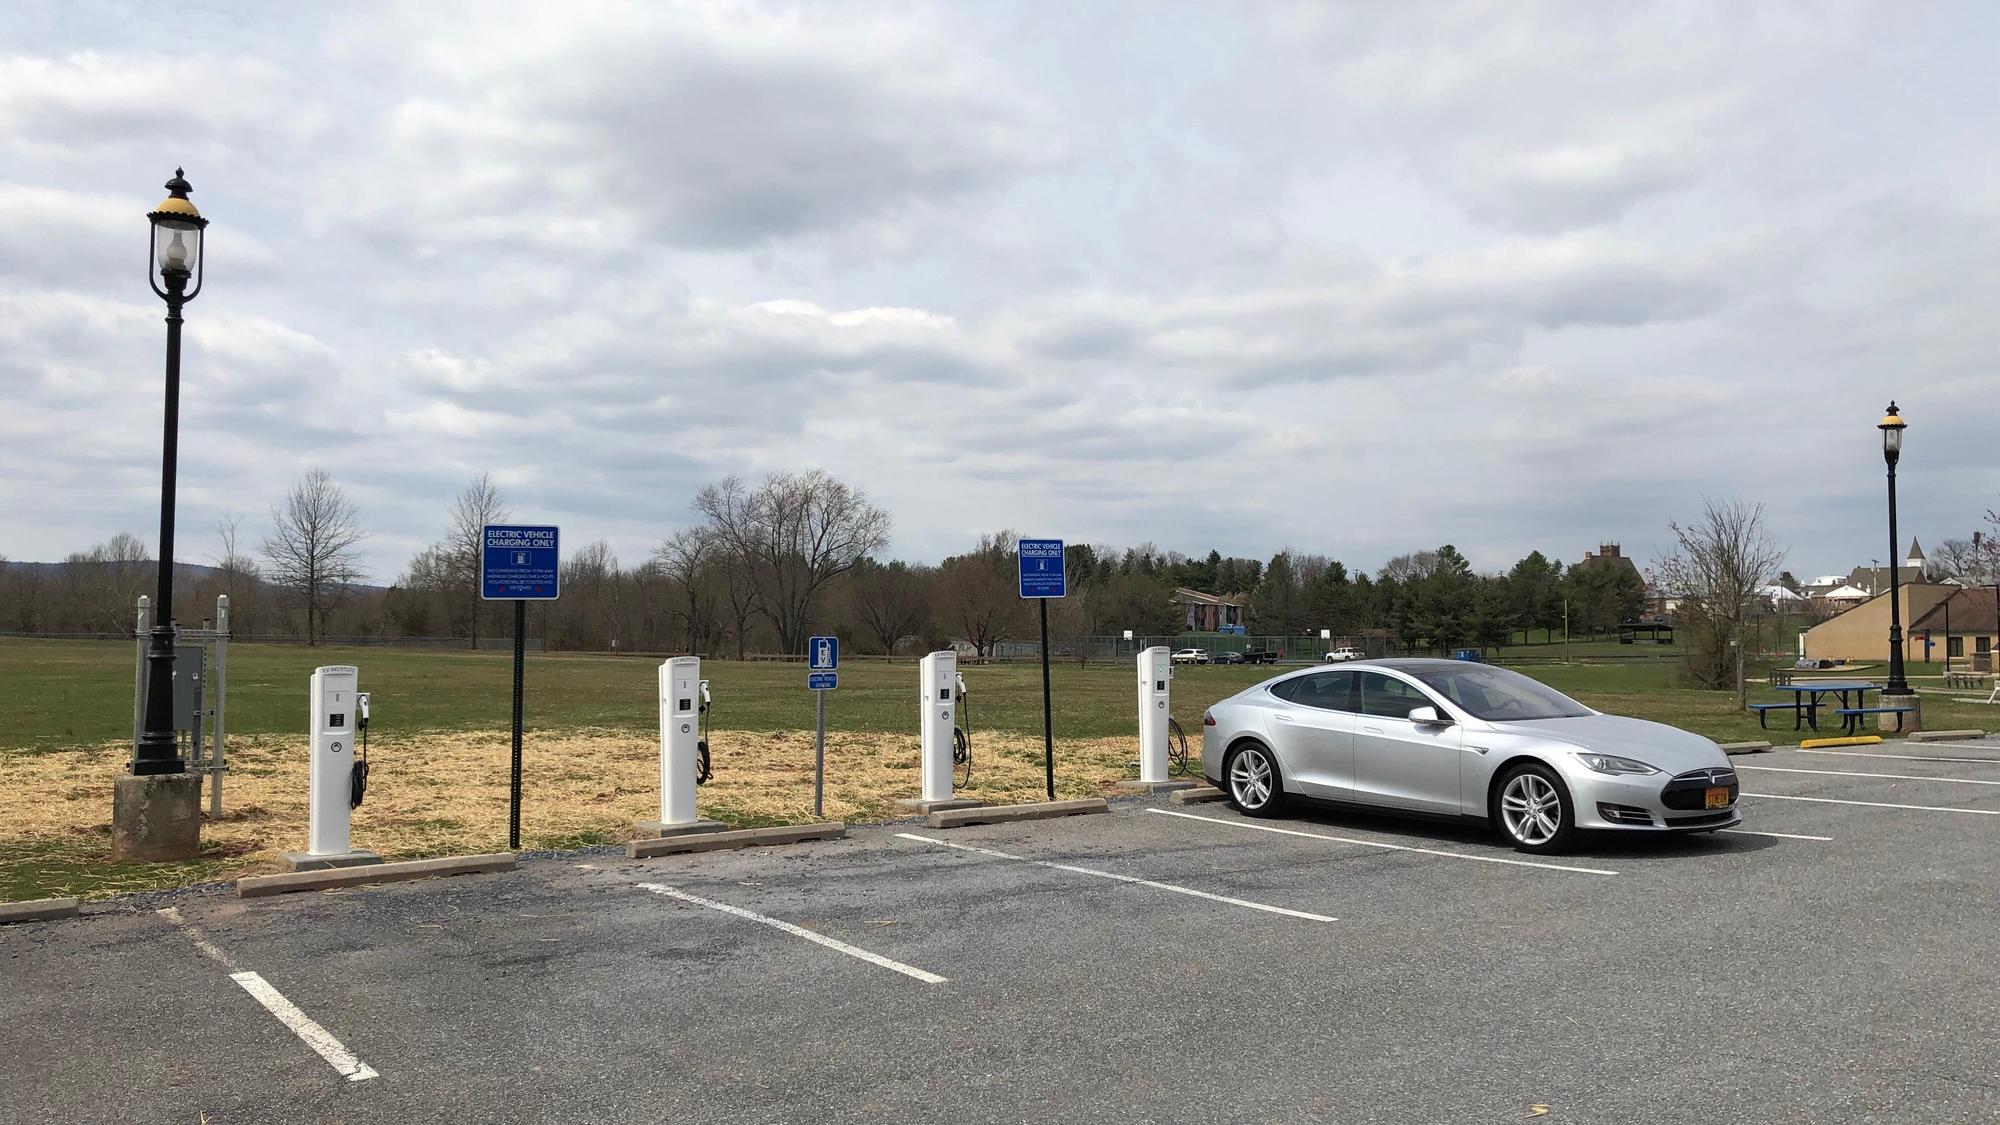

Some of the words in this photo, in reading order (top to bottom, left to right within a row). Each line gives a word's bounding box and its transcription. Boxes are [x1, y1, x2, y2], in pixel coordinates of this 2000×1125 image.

[488, 530, 522, 538] ELECTRIC
[523, 531, 554, 539] VEHICLE
[487, 538, 531, 546] CHARGING
[532, 539, 555, 547] ONLY
[821, 649, 826, 663] EV
